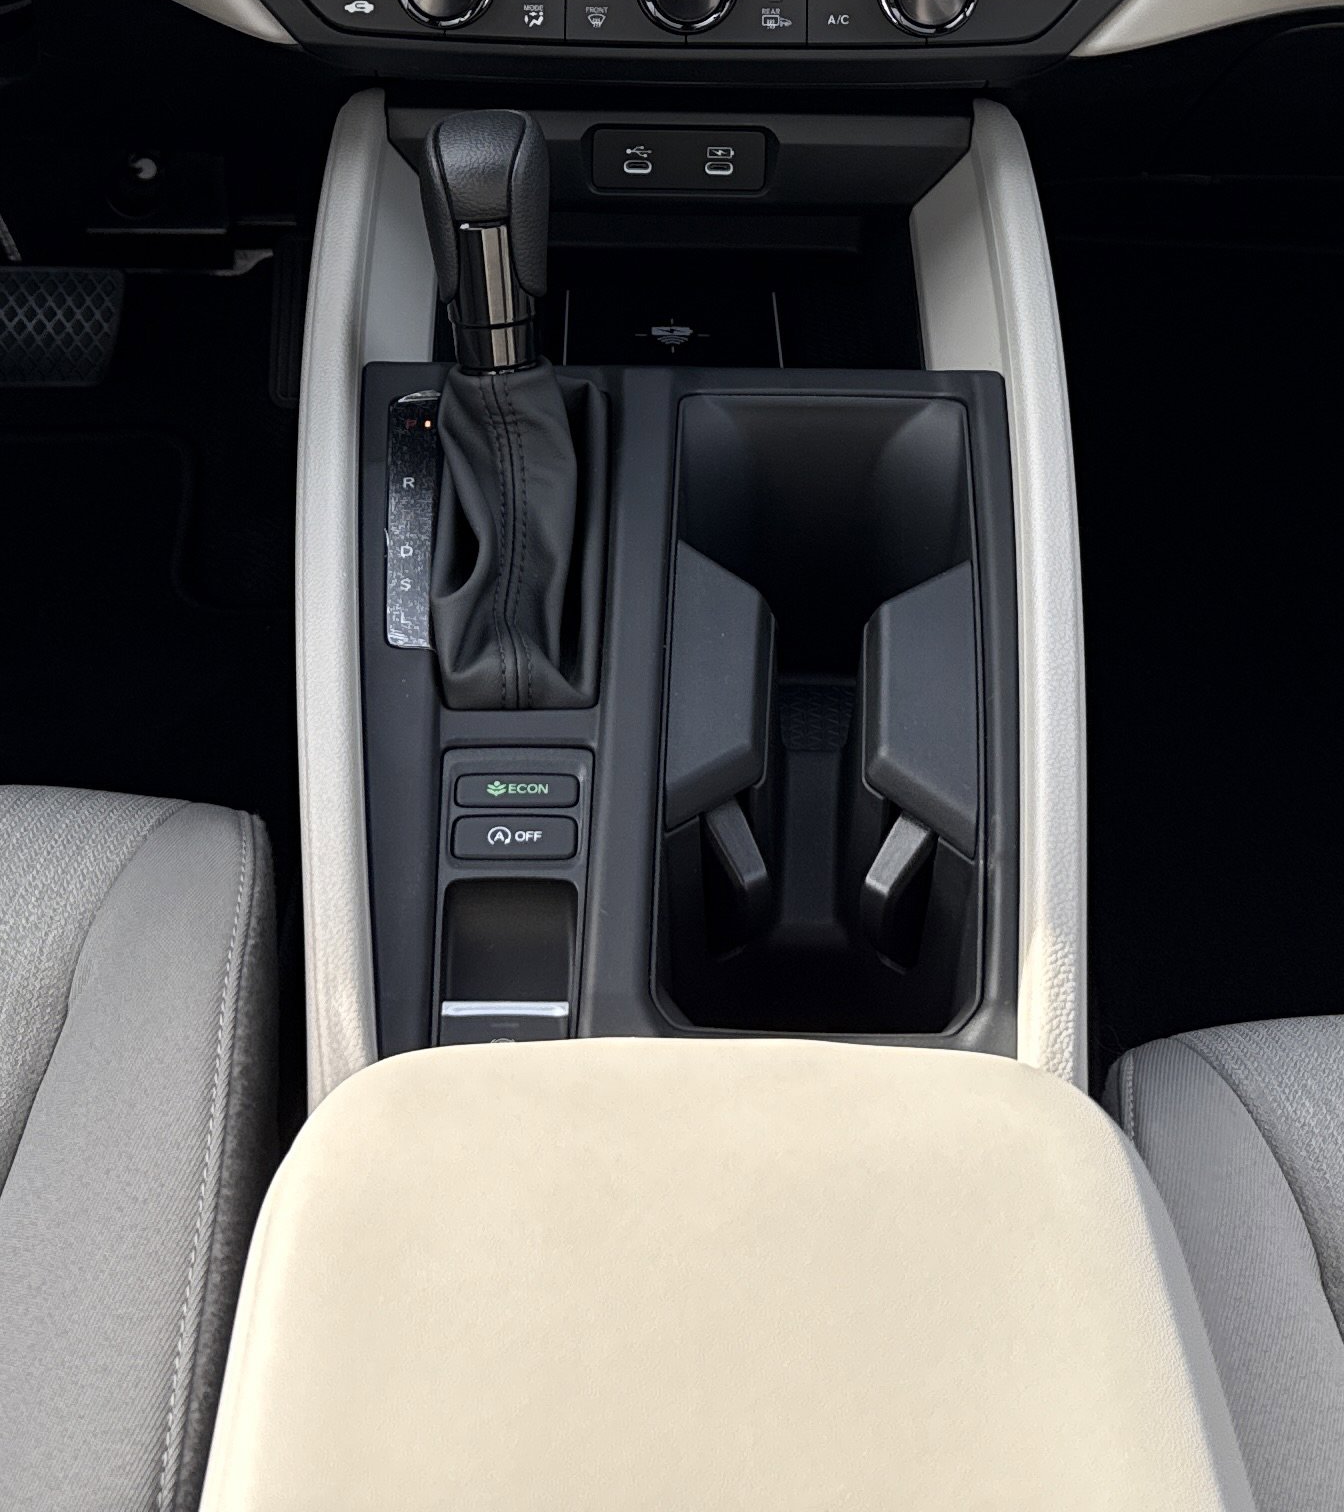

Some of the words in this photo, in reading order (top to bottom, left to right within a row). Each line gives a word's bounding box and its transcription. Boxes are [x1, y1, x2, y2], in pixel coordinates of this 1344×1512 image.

[585, 6, 608, 14] FRONT
[761, 7, 781, 15] REAR
[827, 14, 850, 26] A/C
[402, 476, 416, 488] R
[400, 545, 413, 558] D
[400, 578, 412, 591] S
[508, 783, 549, 794] ECON
[514, 830, 543, 842] OFF
